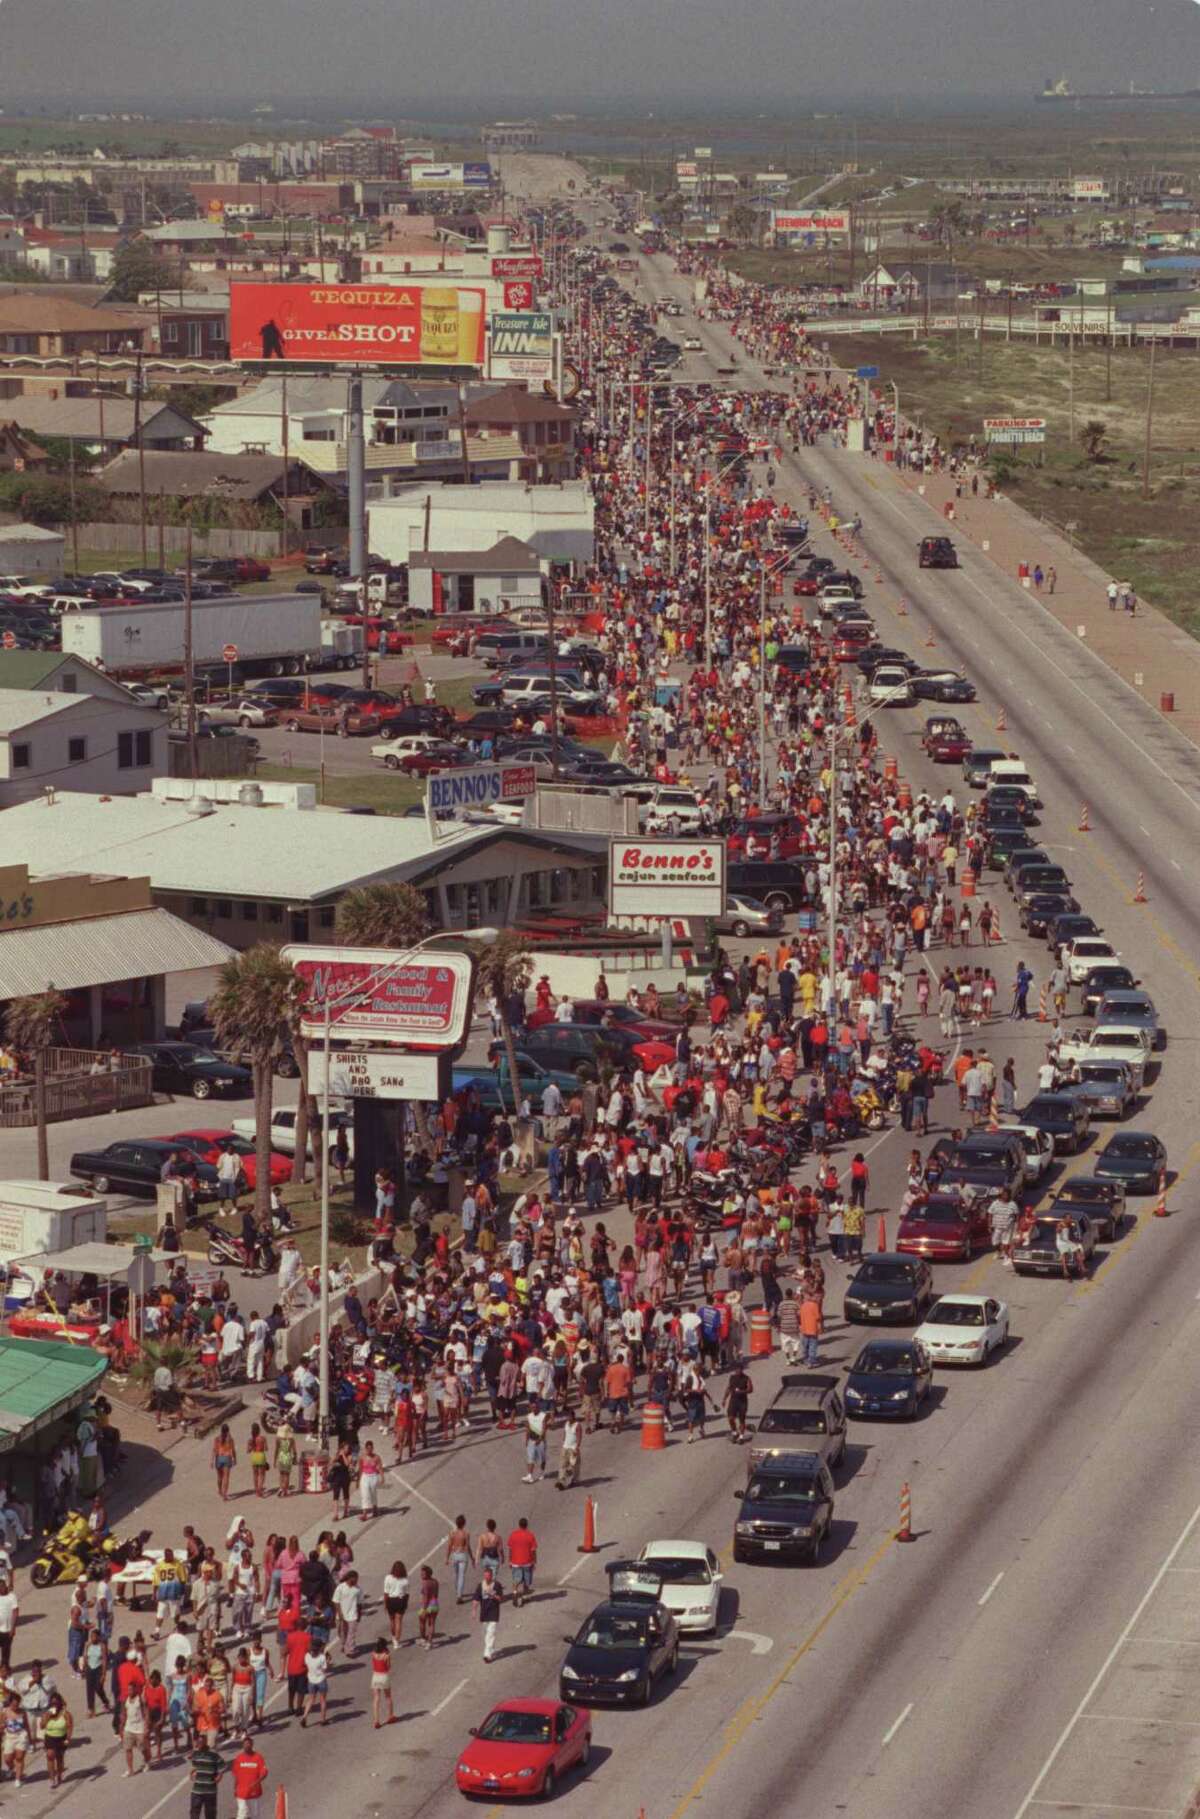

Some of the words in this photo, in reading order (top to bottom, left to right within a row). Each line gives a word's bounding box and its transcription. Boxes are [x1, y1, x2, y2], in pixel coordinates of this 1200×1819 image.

[310, 290, 415, 306] TEQUIZA
[495, 317, 529, 329] Treasure
[532, 317, 549, 330] Isle
[282, 329, 329, 340] GIVE
[339, 324, 415, 343] SHOT
[493, 332, 534, 353] INN
[430, 772, 501, 808] BENNO'S
[621, 848, 714, 869] Benno's
[618, 871, 656, 882] cajun
[662, 871, 716, 882] seafood
[437, 969, 448, 981] &
[386, 983, 432, 1001] Family
[372, 998, 448, 1013] Restaurant
[336, 1054, 368, 1064] SHIRTS
[348, 1065, 367, 1074] AND
[351, 1075, 371, 1086] BBQ
